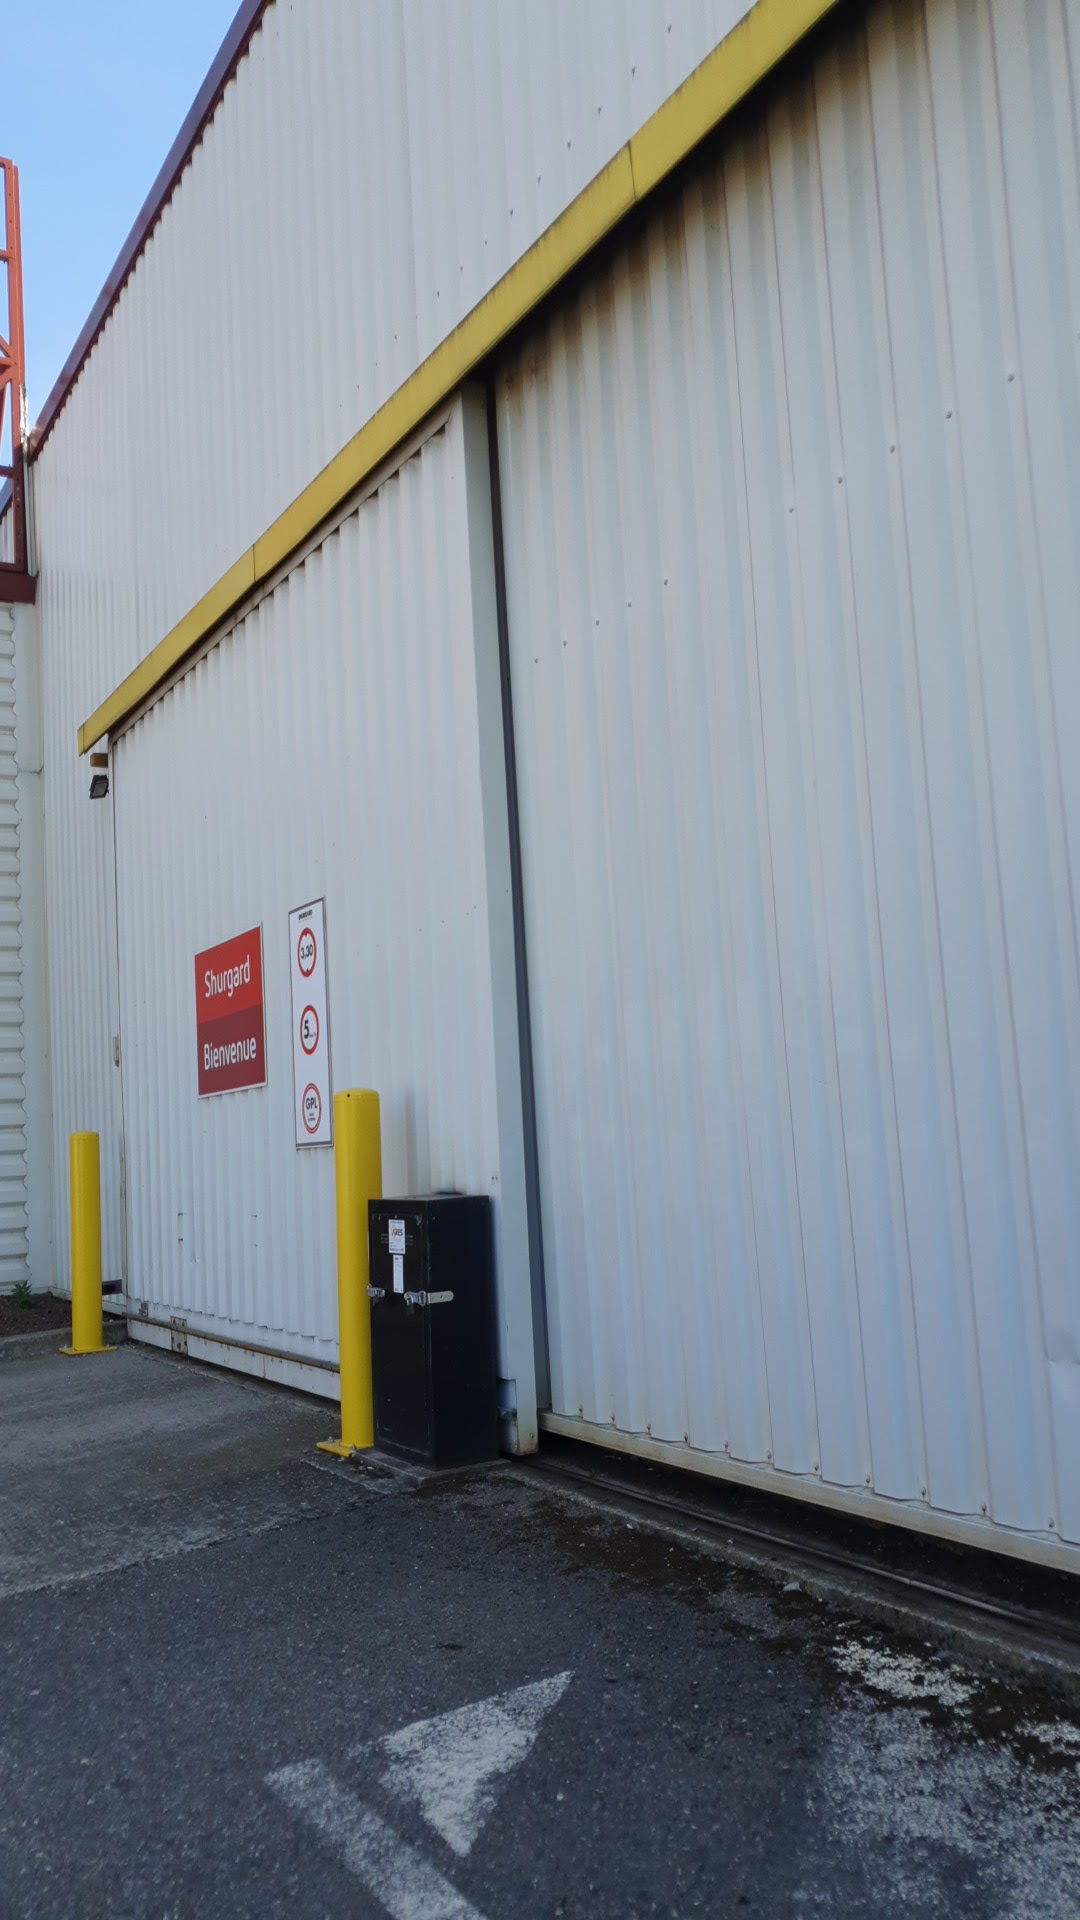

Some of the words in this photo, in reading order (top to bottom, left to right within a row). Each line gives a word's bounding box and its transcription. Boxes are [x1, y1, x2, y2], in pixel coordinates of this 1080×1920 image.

[204, 954, 250, 998] Shurgard
[304, 1019, 310, 1039] 5
[204, 1037, 257, 1071] Bienvenue
[305, 1097, 318, 1110] GPL
